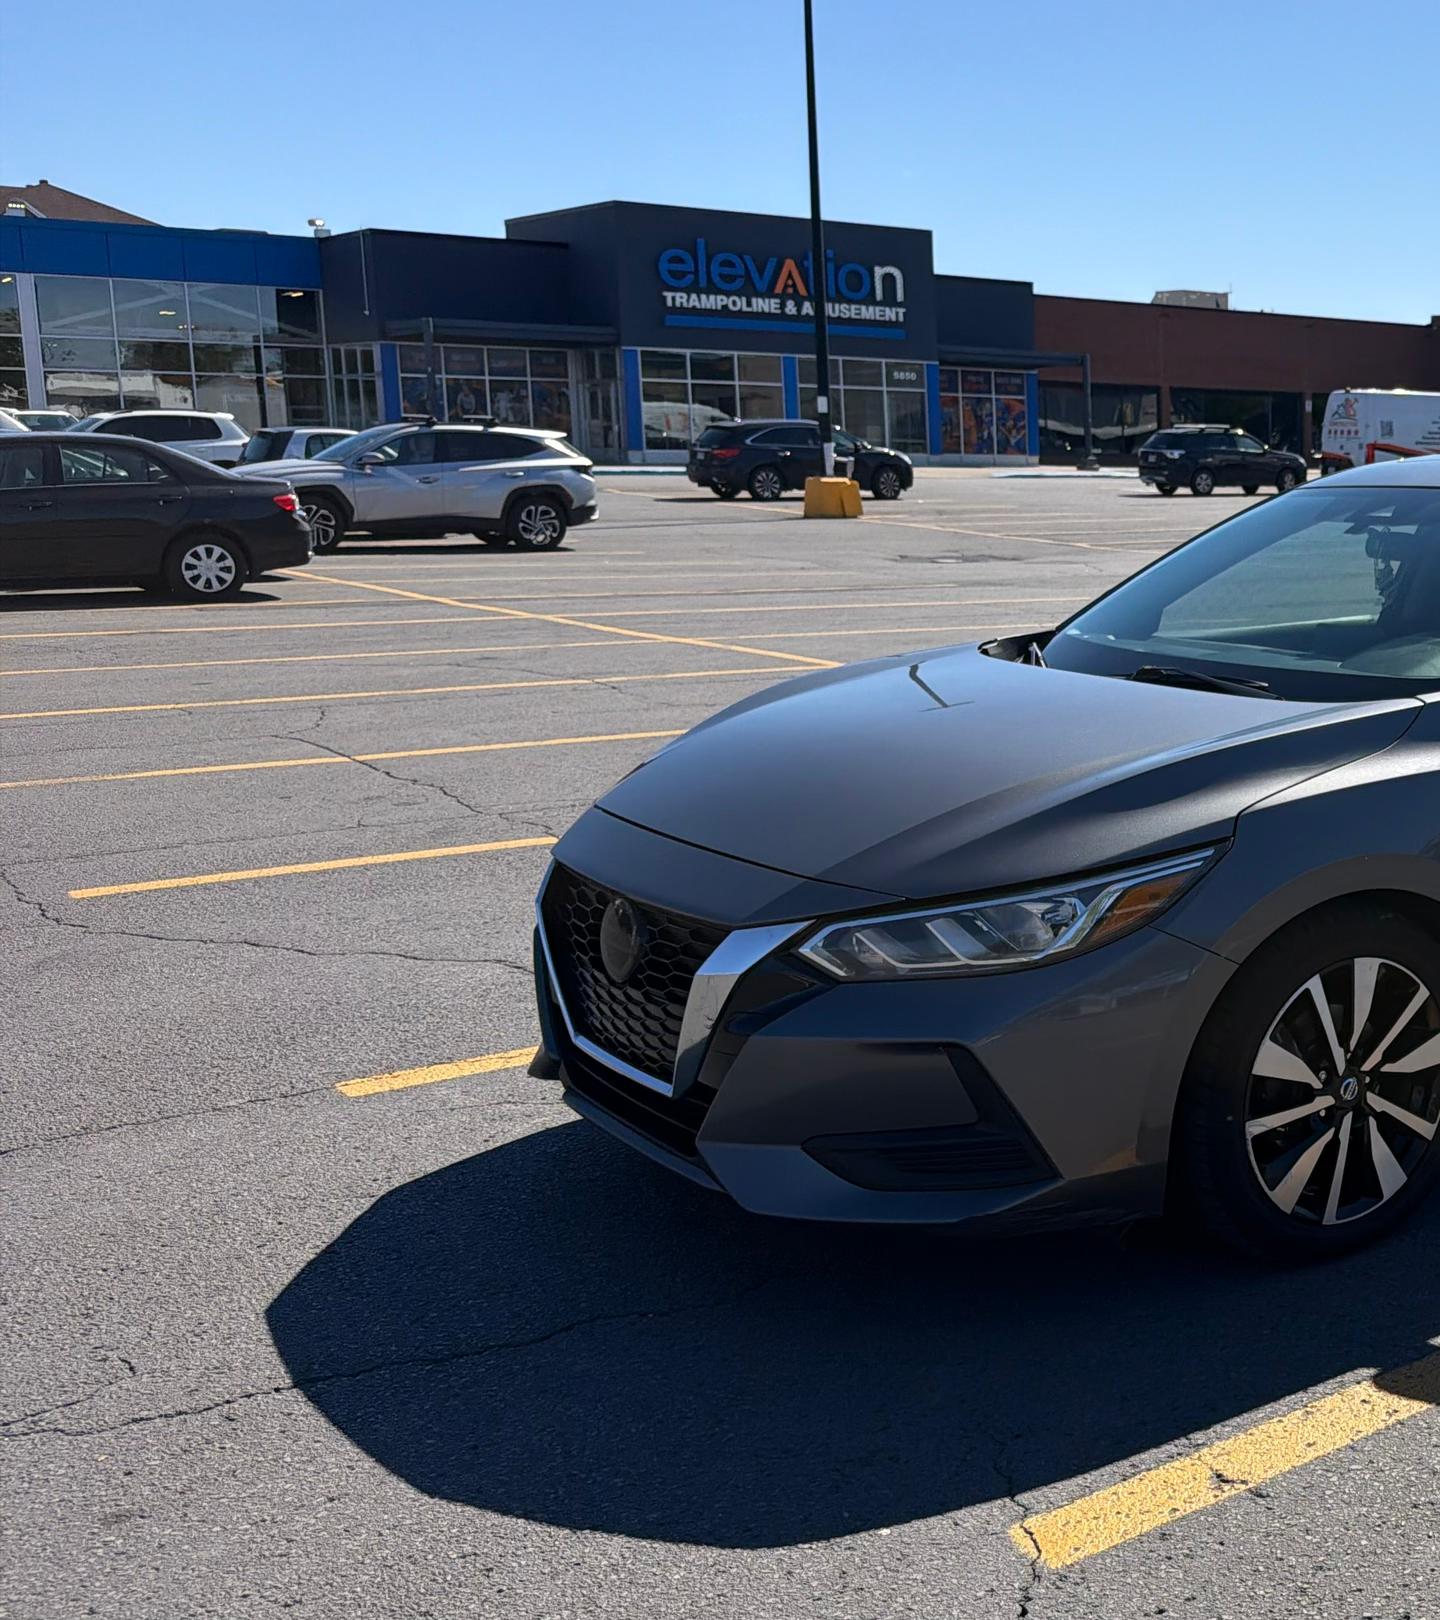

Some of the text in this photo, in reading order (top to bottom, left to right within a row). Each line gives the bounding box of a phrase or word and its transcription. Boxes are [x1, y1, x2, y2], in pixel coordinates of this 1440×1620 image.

[662, 291, 907, 323] TRAMPOLINE & AUSEMENT
